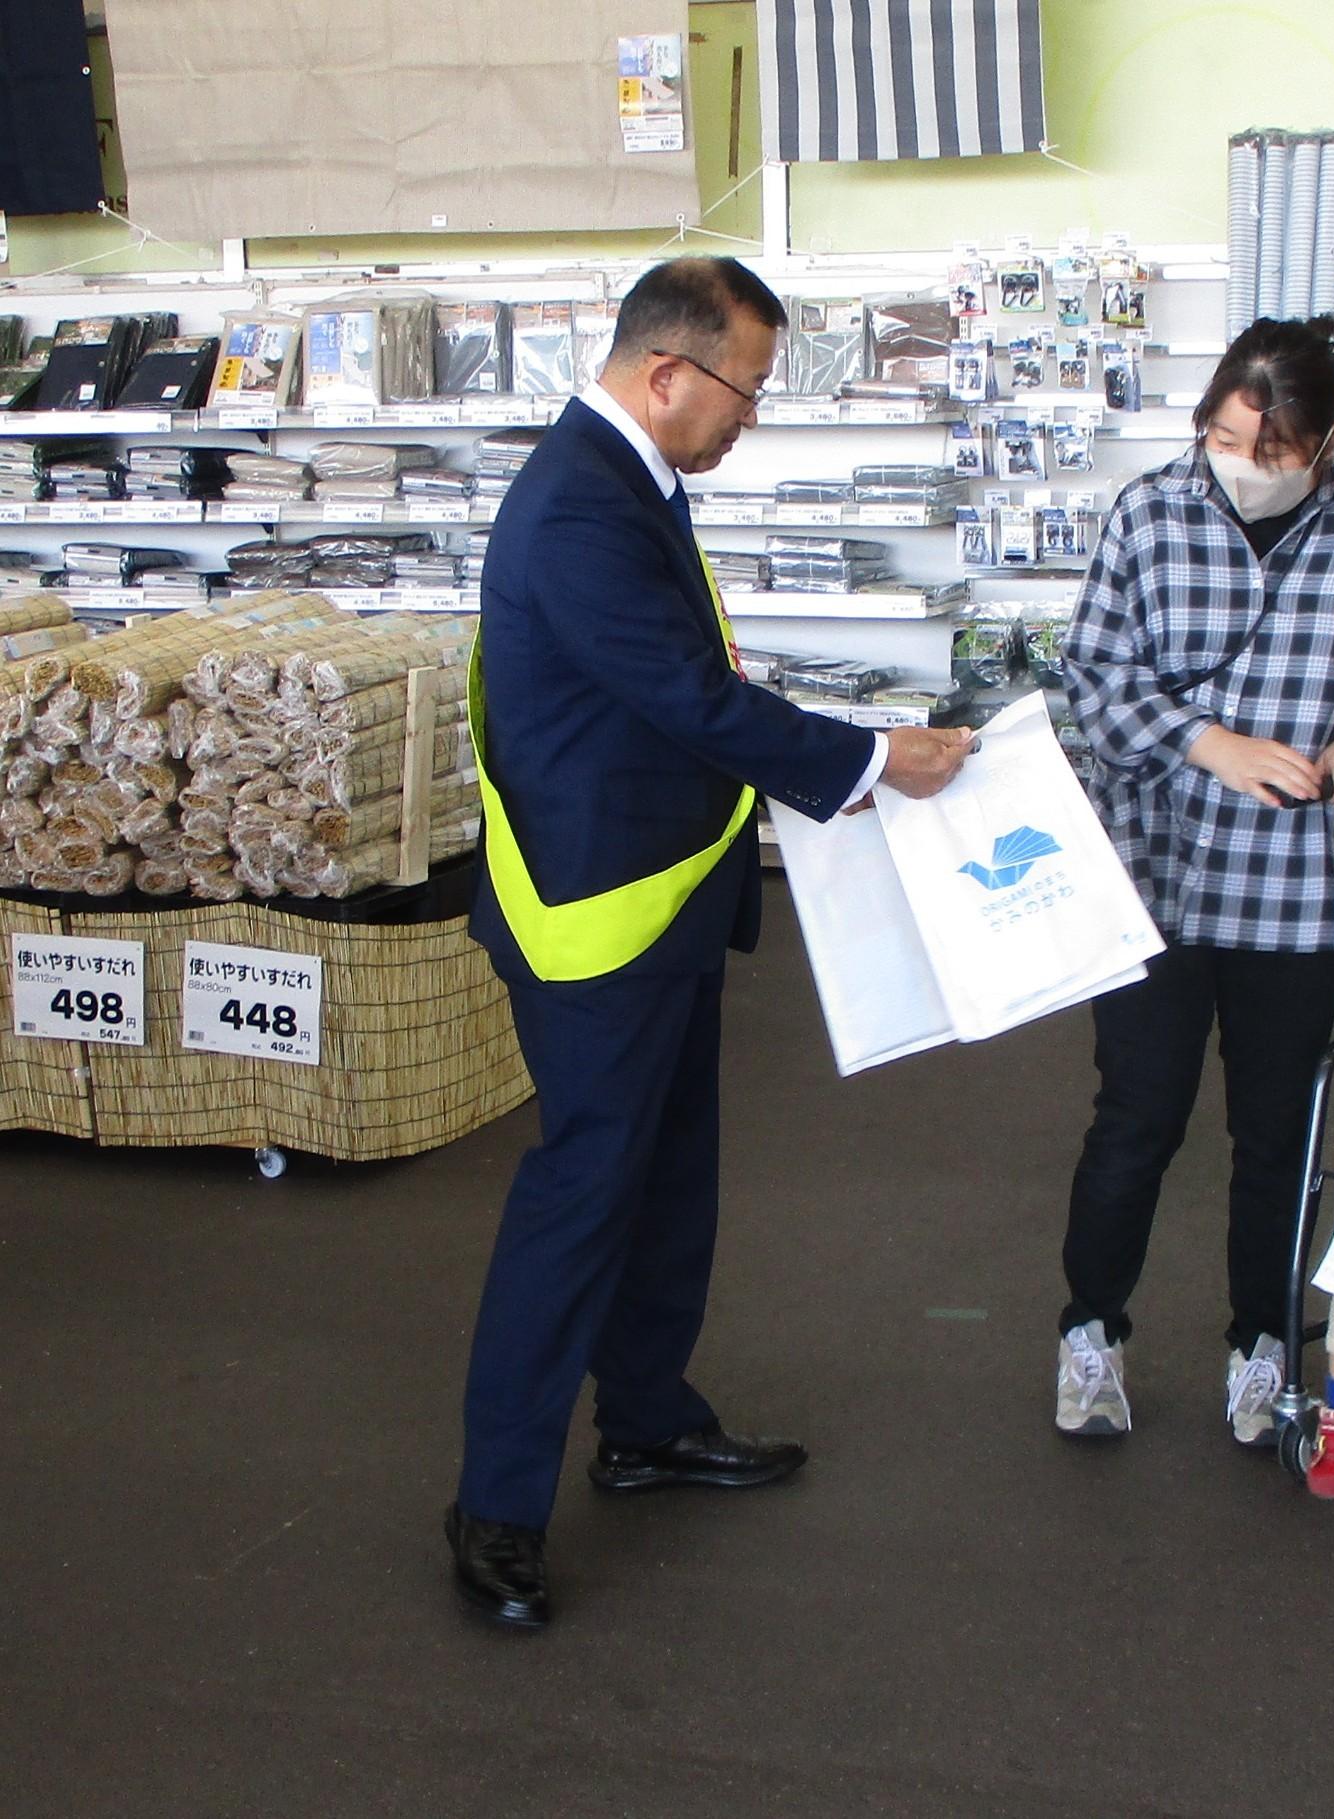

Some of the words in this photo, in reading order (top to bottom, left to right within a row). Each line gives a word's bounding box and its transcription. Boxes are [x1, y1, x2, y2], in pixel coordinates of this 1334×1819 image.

[17, 950, 136, 977] 使いやすいすだれ
[188, 957, 312, 991] 使いやすいすだれ
